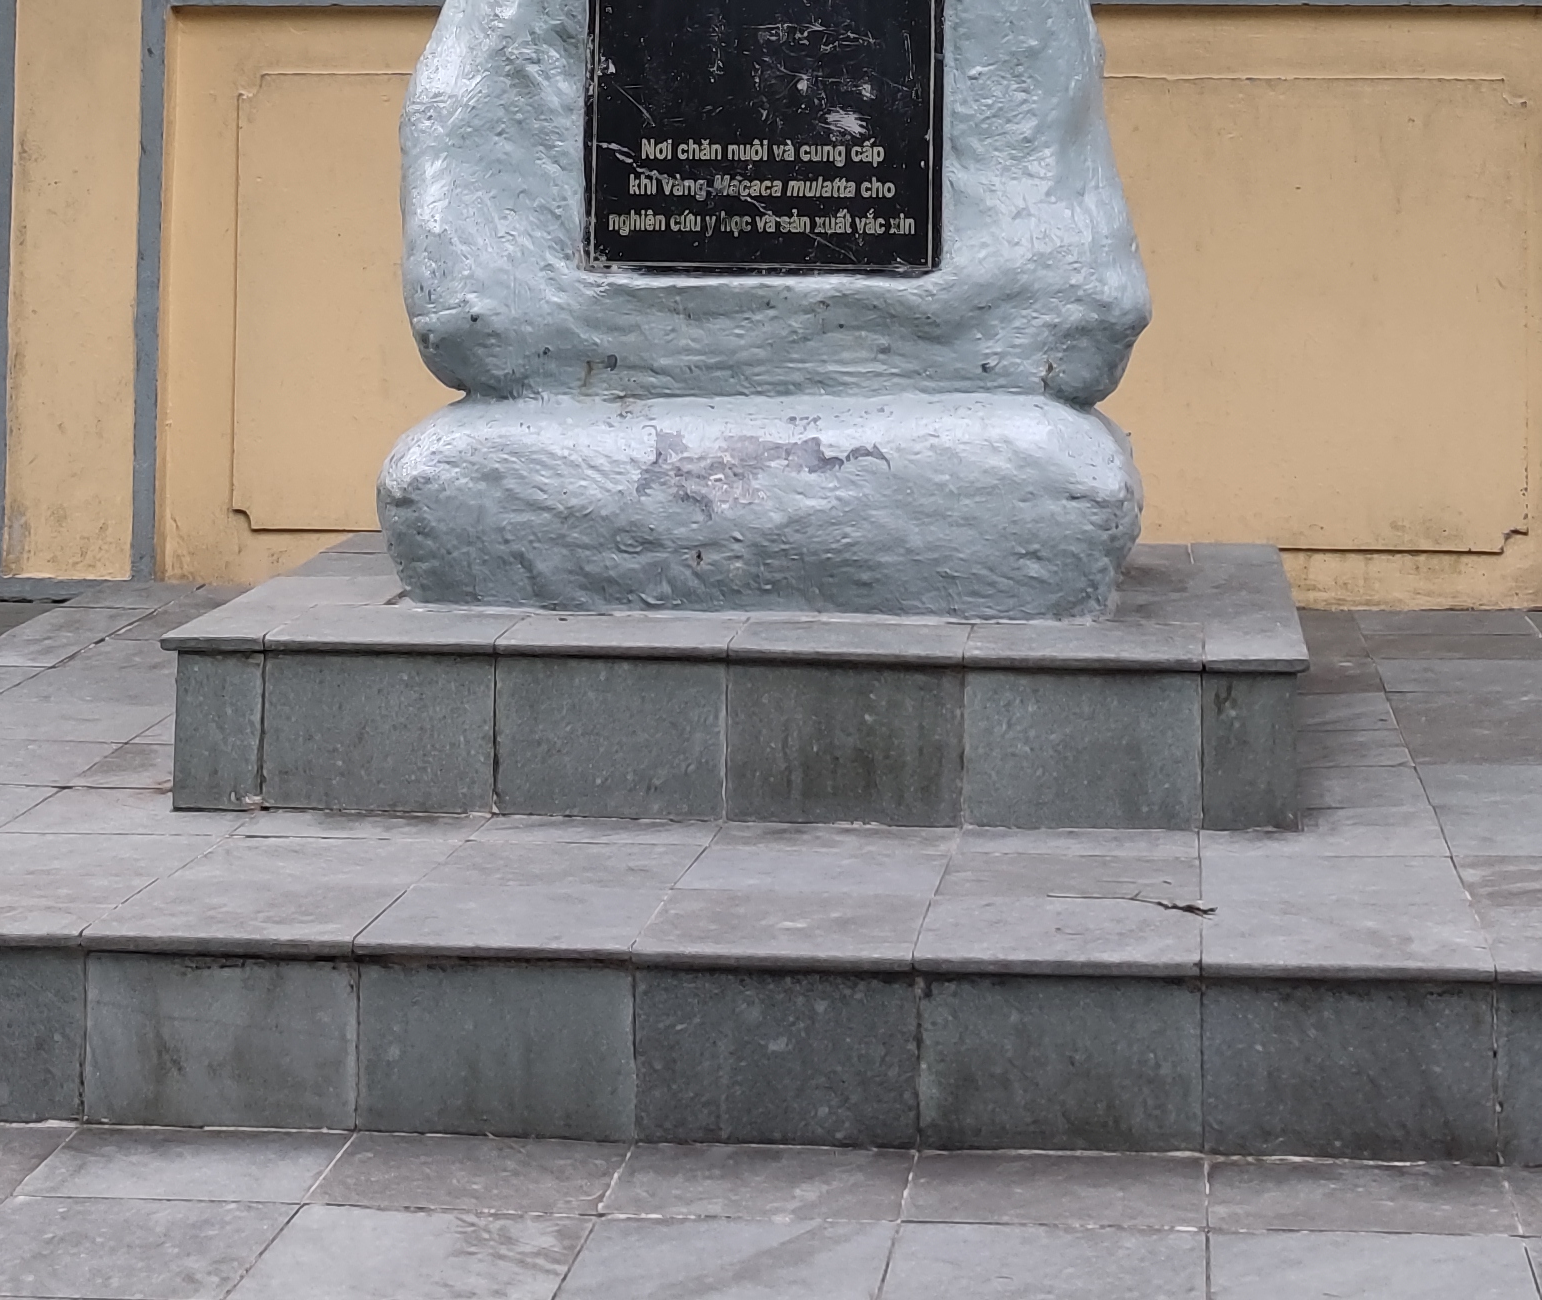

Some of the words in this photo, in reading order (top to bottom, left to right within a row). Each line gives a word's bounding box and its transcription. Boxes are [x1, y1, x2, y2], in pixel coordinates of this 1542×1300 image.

[641, 138, 673, 160] Nơi
[677, 138, 722, 161] chăn
[727, 138, 769, 161] nuôi
[772, 139, 795, 161] và
[799, 145, 846, 167] cung
[850, 138, 885, 167] cấp
[786, 176, 857, 198] mulatta
[860, 177, 896, 198] cho
[608, 209, 666, 235] nghiên
[670, 210, 701, 232] cứu
[705, 215, 716, 237] y
[720, 210, 752, 237] học
[755, 211, 776, 232] và
[780, 209, 810, 233] sản
[814, 208, 853, 234] xuất
[855, 208, 886, 234] vắc
[889, 213, 915, 235] xin
